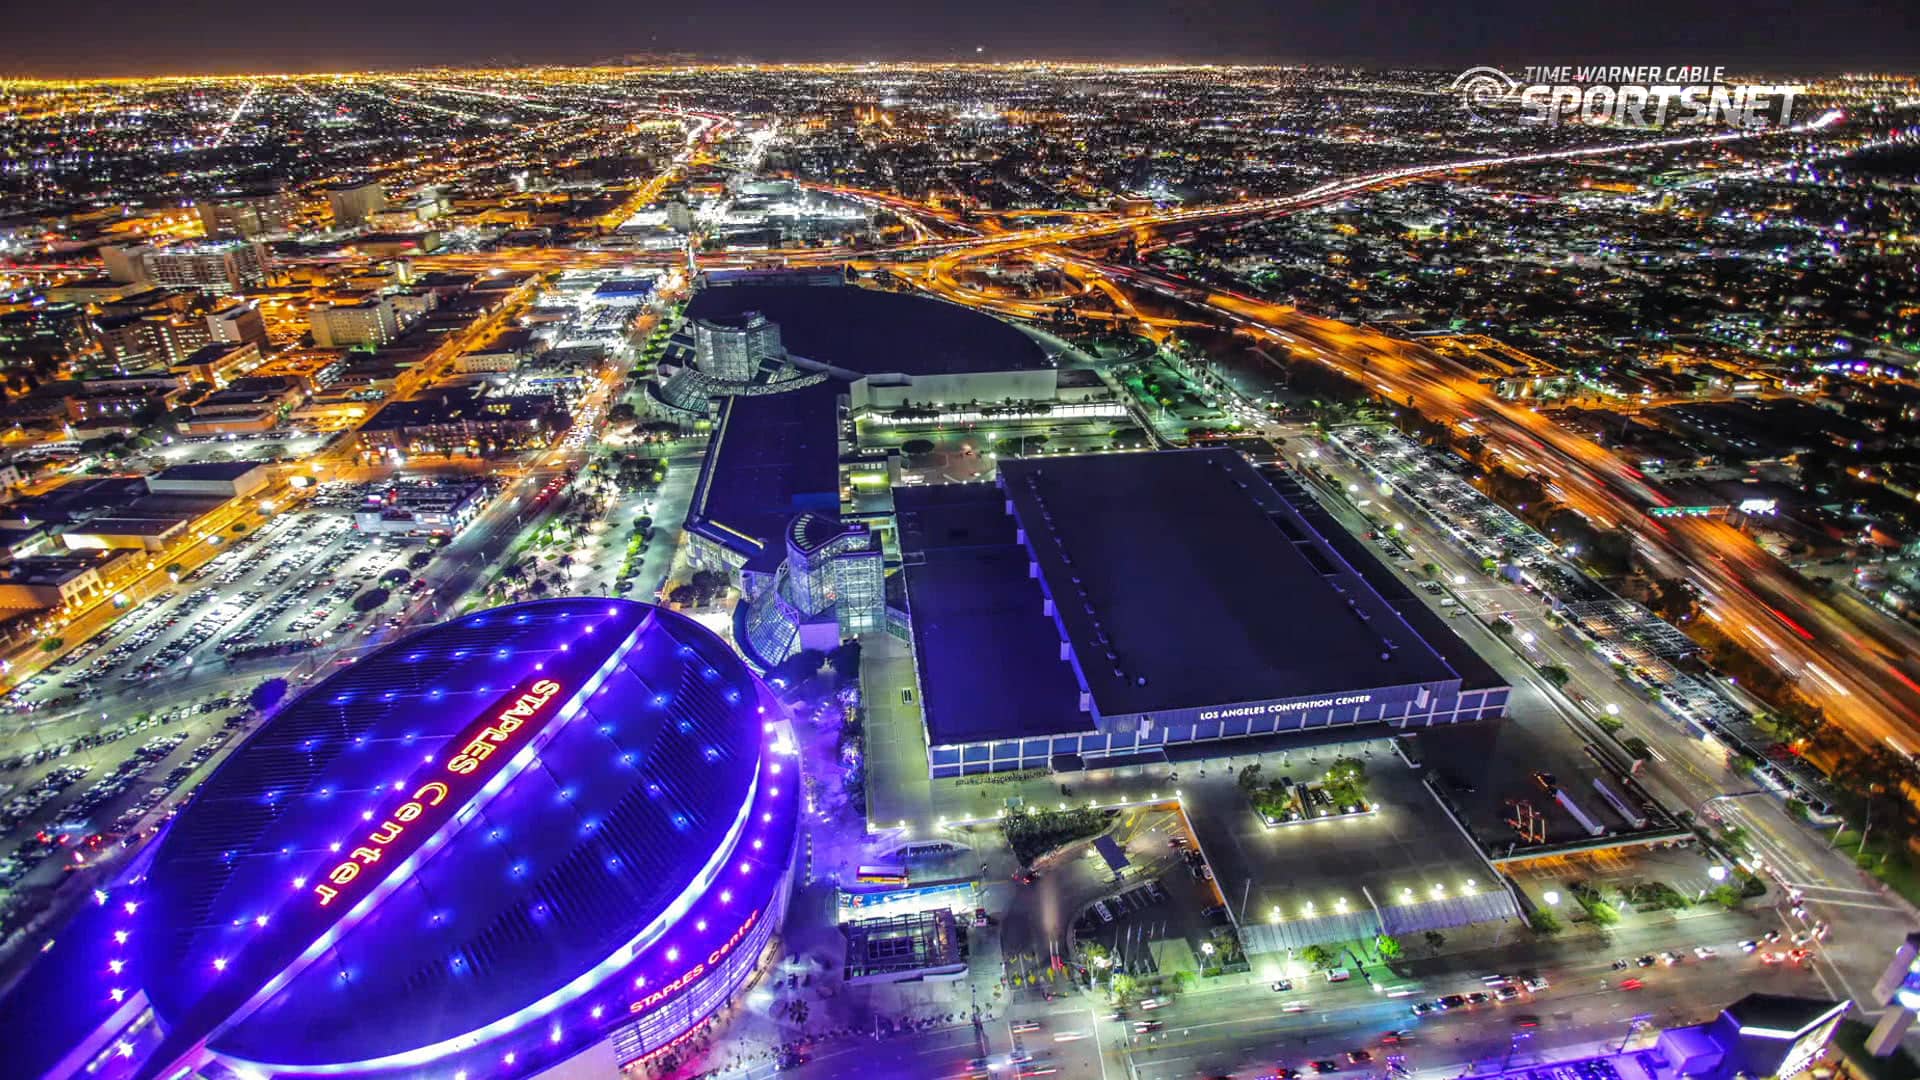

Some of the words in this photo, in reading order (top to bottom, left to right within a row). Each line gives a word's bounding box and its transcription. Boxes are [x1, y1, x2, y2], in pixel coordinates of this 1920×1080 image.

[447, 679, 561, 775] STAPLES
[1200, 711, 1219, 721] LOS
[1221, 706, 1265, 718] ANGELES
[1268, 699, 1333, 714] CONVENTION
[1335, 695, 1371, 705] CENTER
[314, 781, 448, 906] Center
[629, 963, 705, 1014] STAPLES
[708, 908, 760, 965] Center
